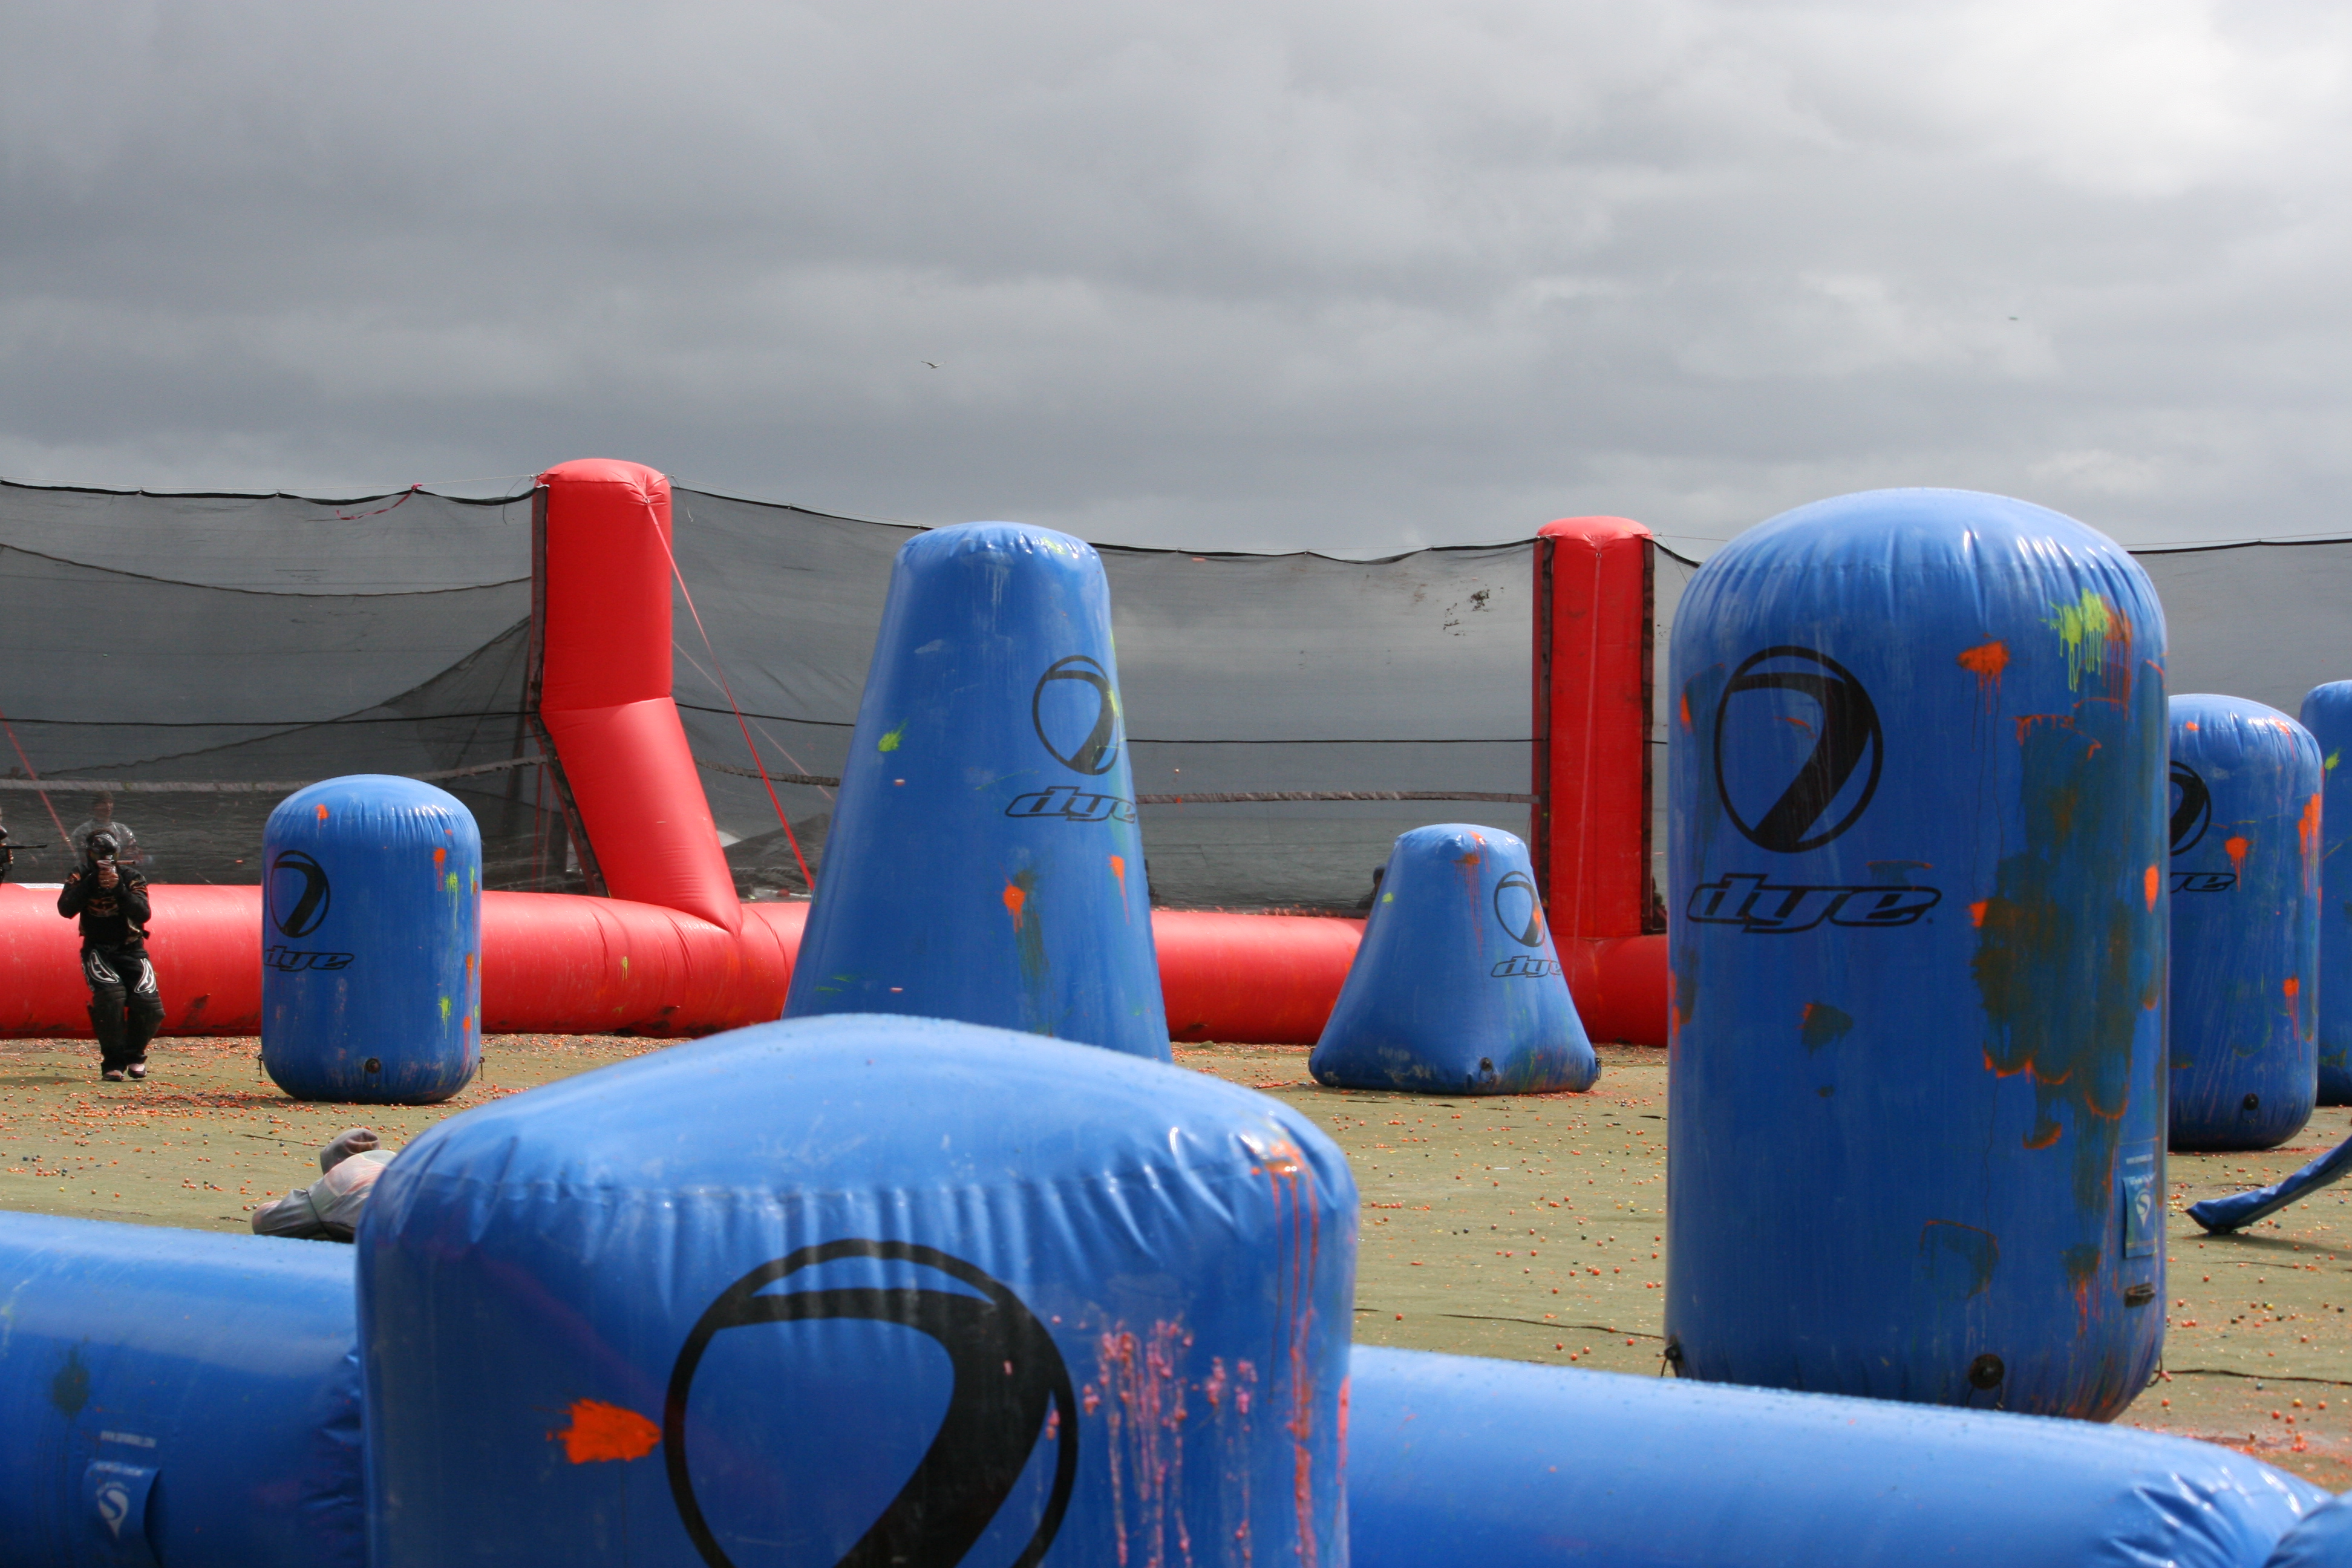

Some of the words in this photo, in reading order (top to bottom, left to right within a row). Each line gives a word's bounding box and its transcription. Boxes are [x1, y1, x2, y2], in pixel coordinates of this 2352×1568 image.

[1005, 786, 1136, 824] dye
[1687, 873, 1942, 933] dye
[263, 945, 355, 972] dye
